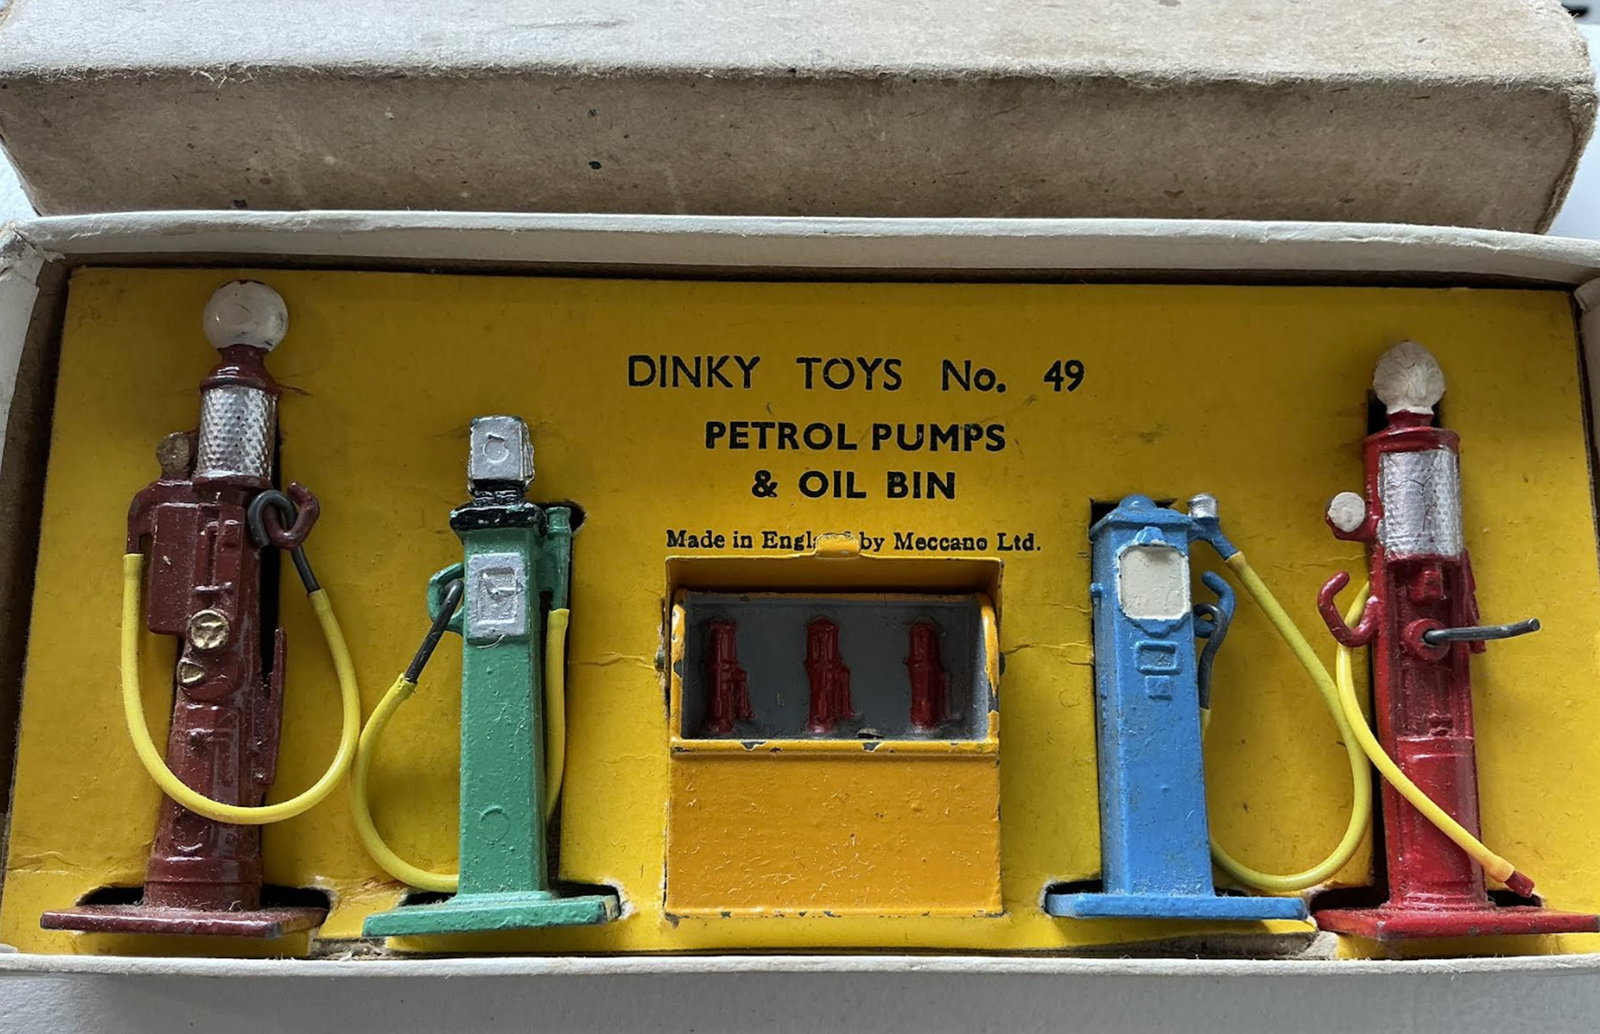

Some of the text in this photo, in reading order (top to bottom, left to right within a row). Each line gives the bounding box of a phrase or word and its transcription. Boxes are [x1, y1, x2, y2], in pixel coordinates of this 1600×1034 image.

[628, 355, 1084, 393] DINKY TOYS No. 49
[706, 421, 1005, 451] PETROL PUMPS
[752, 470, 955, 499] & OIL BIN
[667, 530, 1041, 551] Made in Engl by Meccano Ltd.
